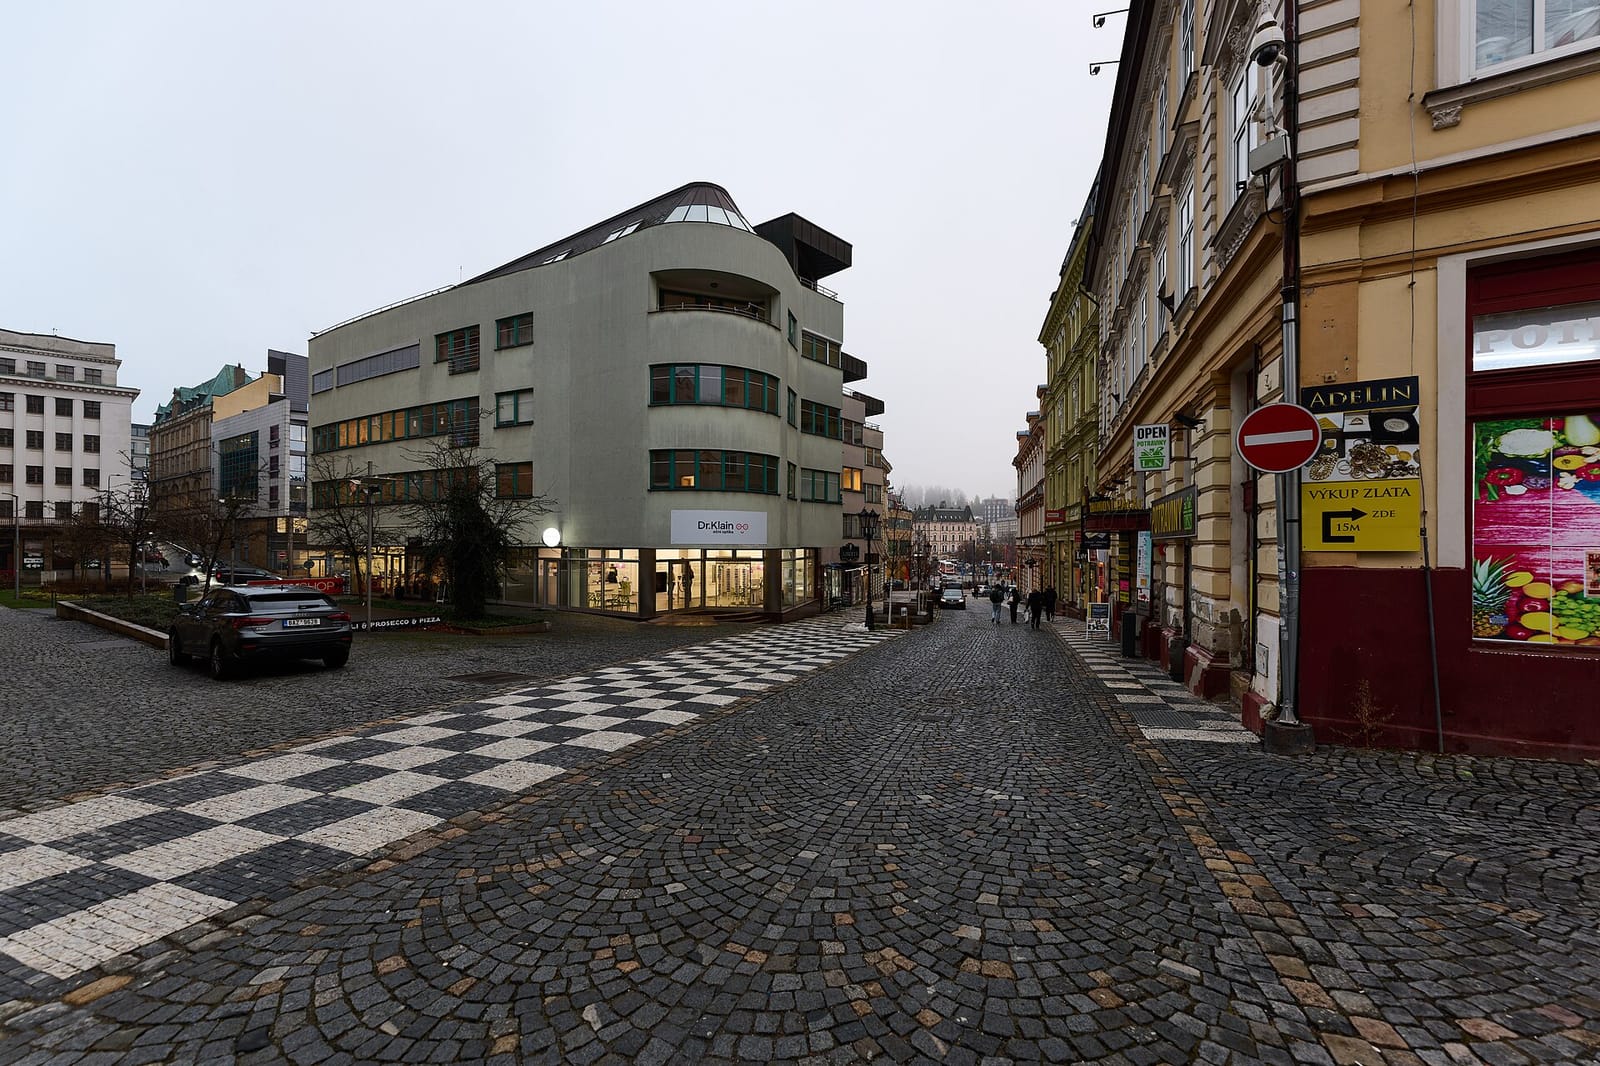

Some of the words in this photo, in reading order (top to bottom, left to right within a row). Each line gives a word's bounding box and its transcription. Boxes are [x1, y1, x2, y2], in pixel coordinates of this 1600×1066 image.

[1310, 385, 1411, 407] ADELIN
[1137, 426, 1167, 439] OPEN
[1309, 488, 1359, 499] VÝKUP
[1363, 487, 1412, 498] ZLATA
[1372, 510, 1396, 518] ZDE
[370, 619, 409, 628] PROSECCO
